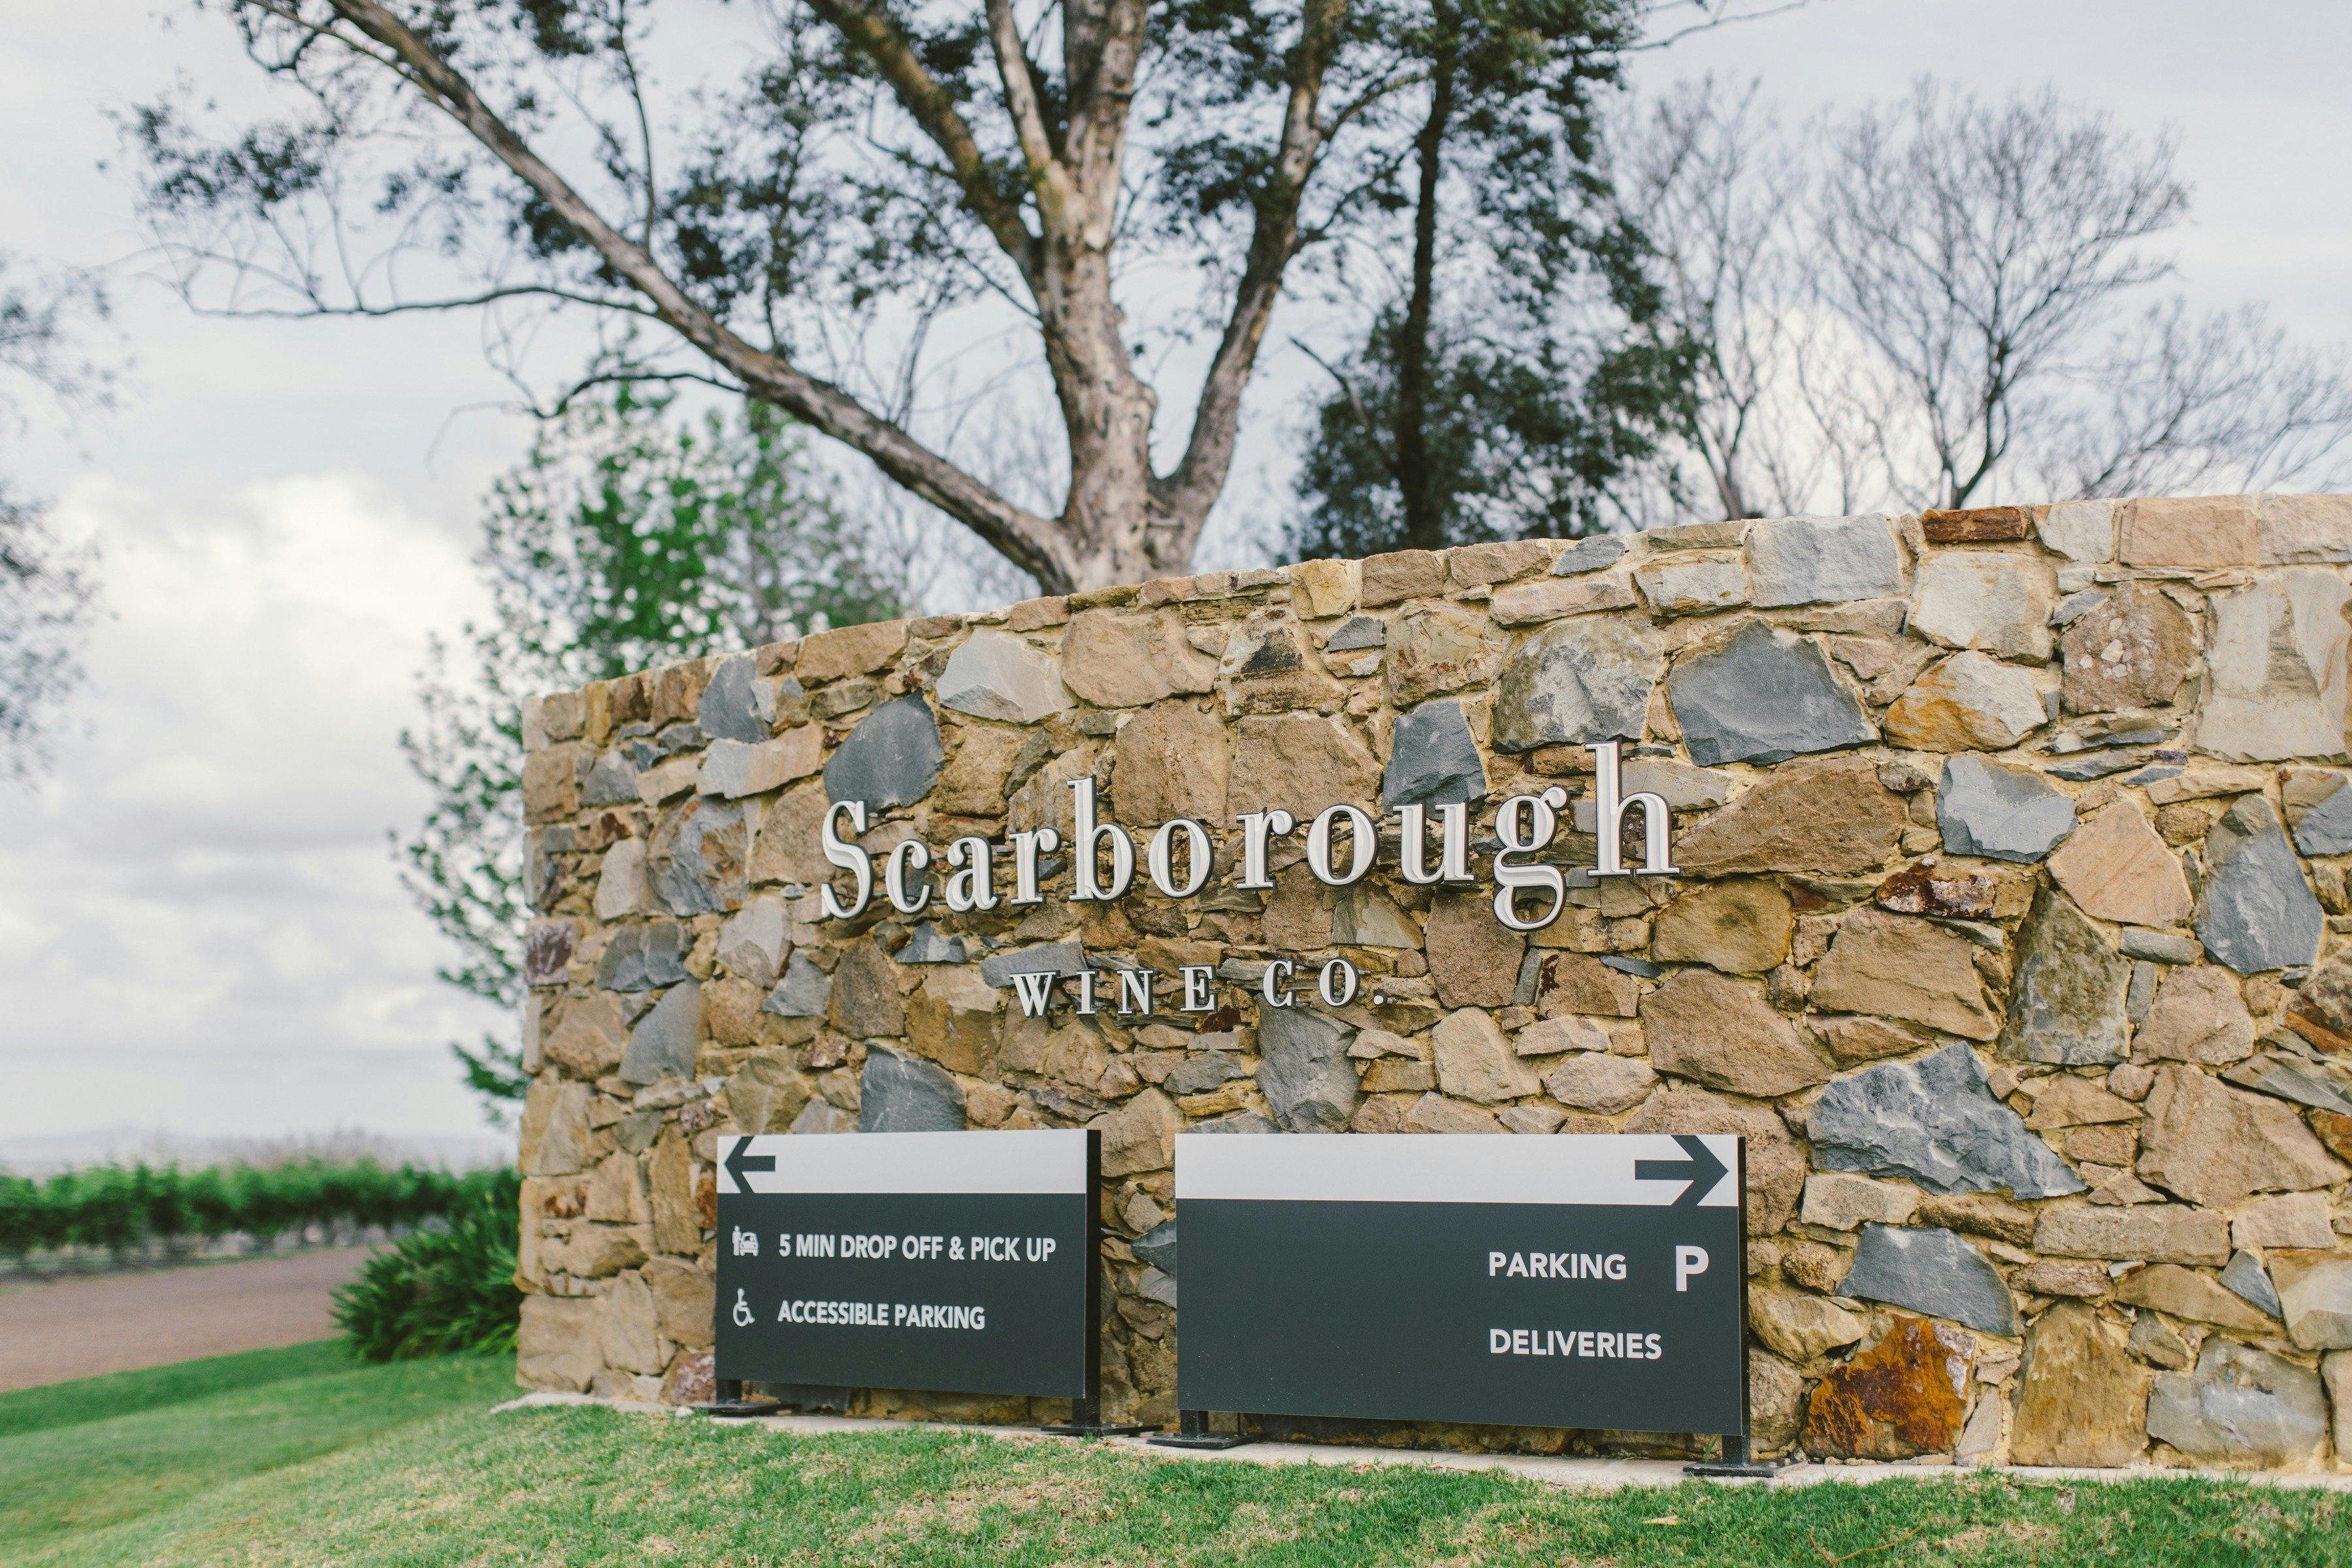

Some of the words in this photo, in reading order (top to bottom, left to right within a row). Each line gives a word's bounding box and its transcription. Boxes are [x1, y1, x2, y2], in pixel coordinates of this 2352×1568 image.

[821, 740, 1681, 932] Scarborough
[1010, 964, 1217, 1018] WINE
[1262, 957, 1390, 1009] CO.
[779, 1233, 791, 1257] 5
[796, 1233, 835, 1258] MIN
[840, 1234, 898, 1259] DROP
[902, 1235, 944, 1260] OFF
[948, 1235, 965, 1261] &
[970, 1236, 1021, 1262] PICK
[1026, 1237, 1056, 1262] UP
[1489, 1251, 1627, 1281] PARKING
[1675, 1245, 1709, 1292] P
[777, 1299, 889, 1326] ACCESSIBLE
[894, 1303, 985, 1330] PARKING
[1490, 1328, 1662, 1360] DELIVERIES
